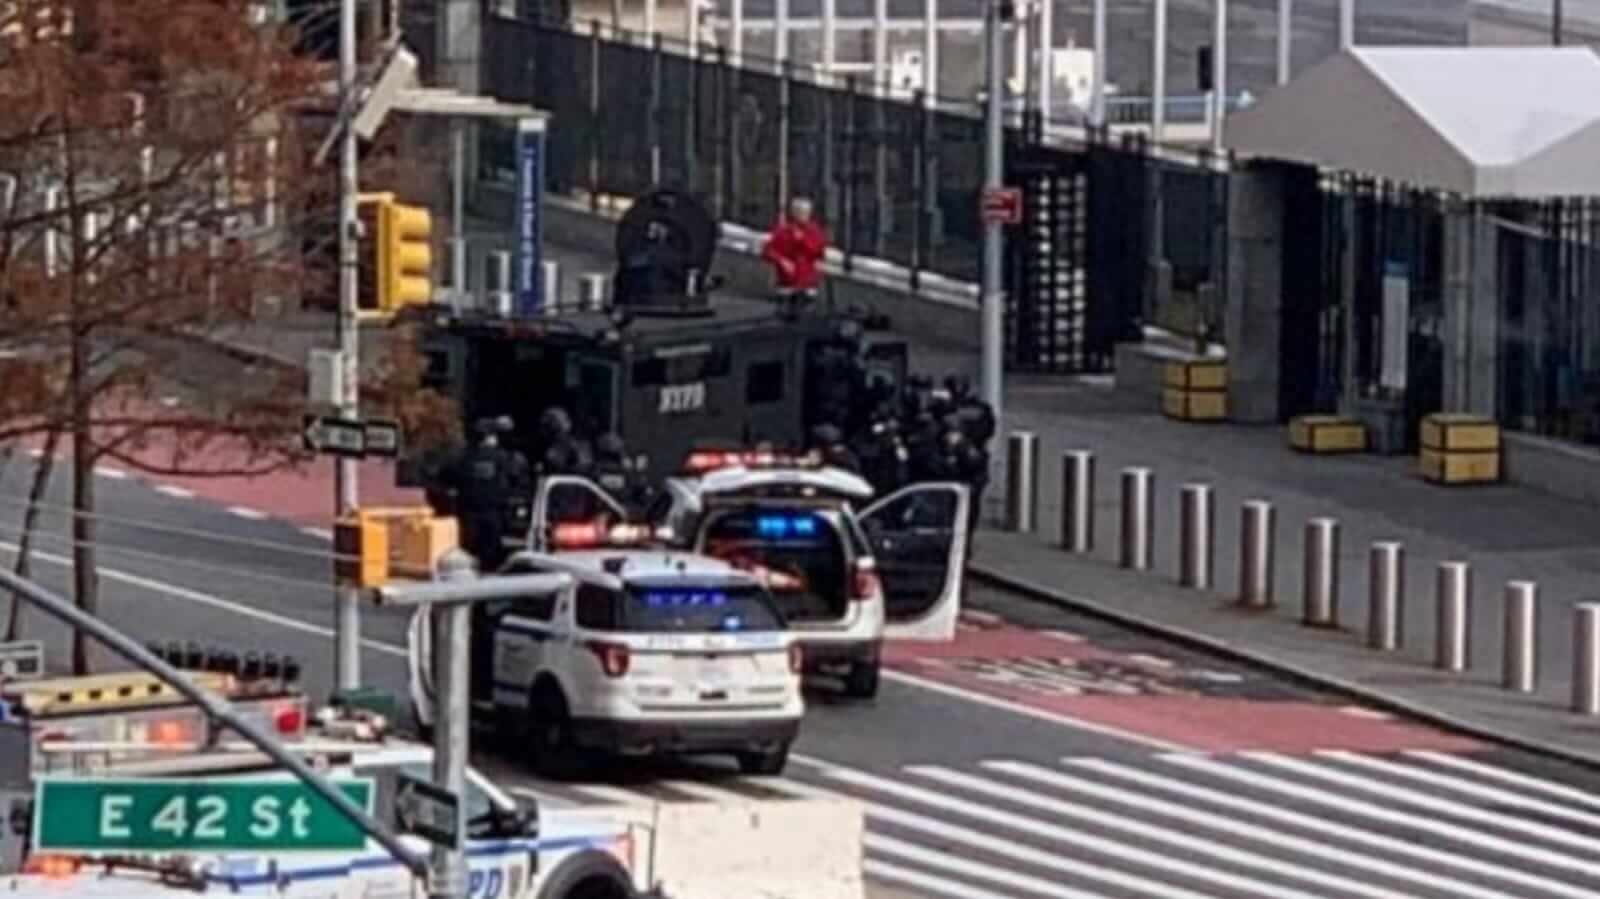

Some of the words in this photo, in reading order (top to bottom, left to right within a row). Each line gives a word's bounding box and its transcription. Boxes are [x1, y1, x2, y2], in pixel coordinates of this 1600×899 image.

[100, 795, 134, 838] E
[152, 795, 229, 838] 42
[249, 795, 312, 838] St
